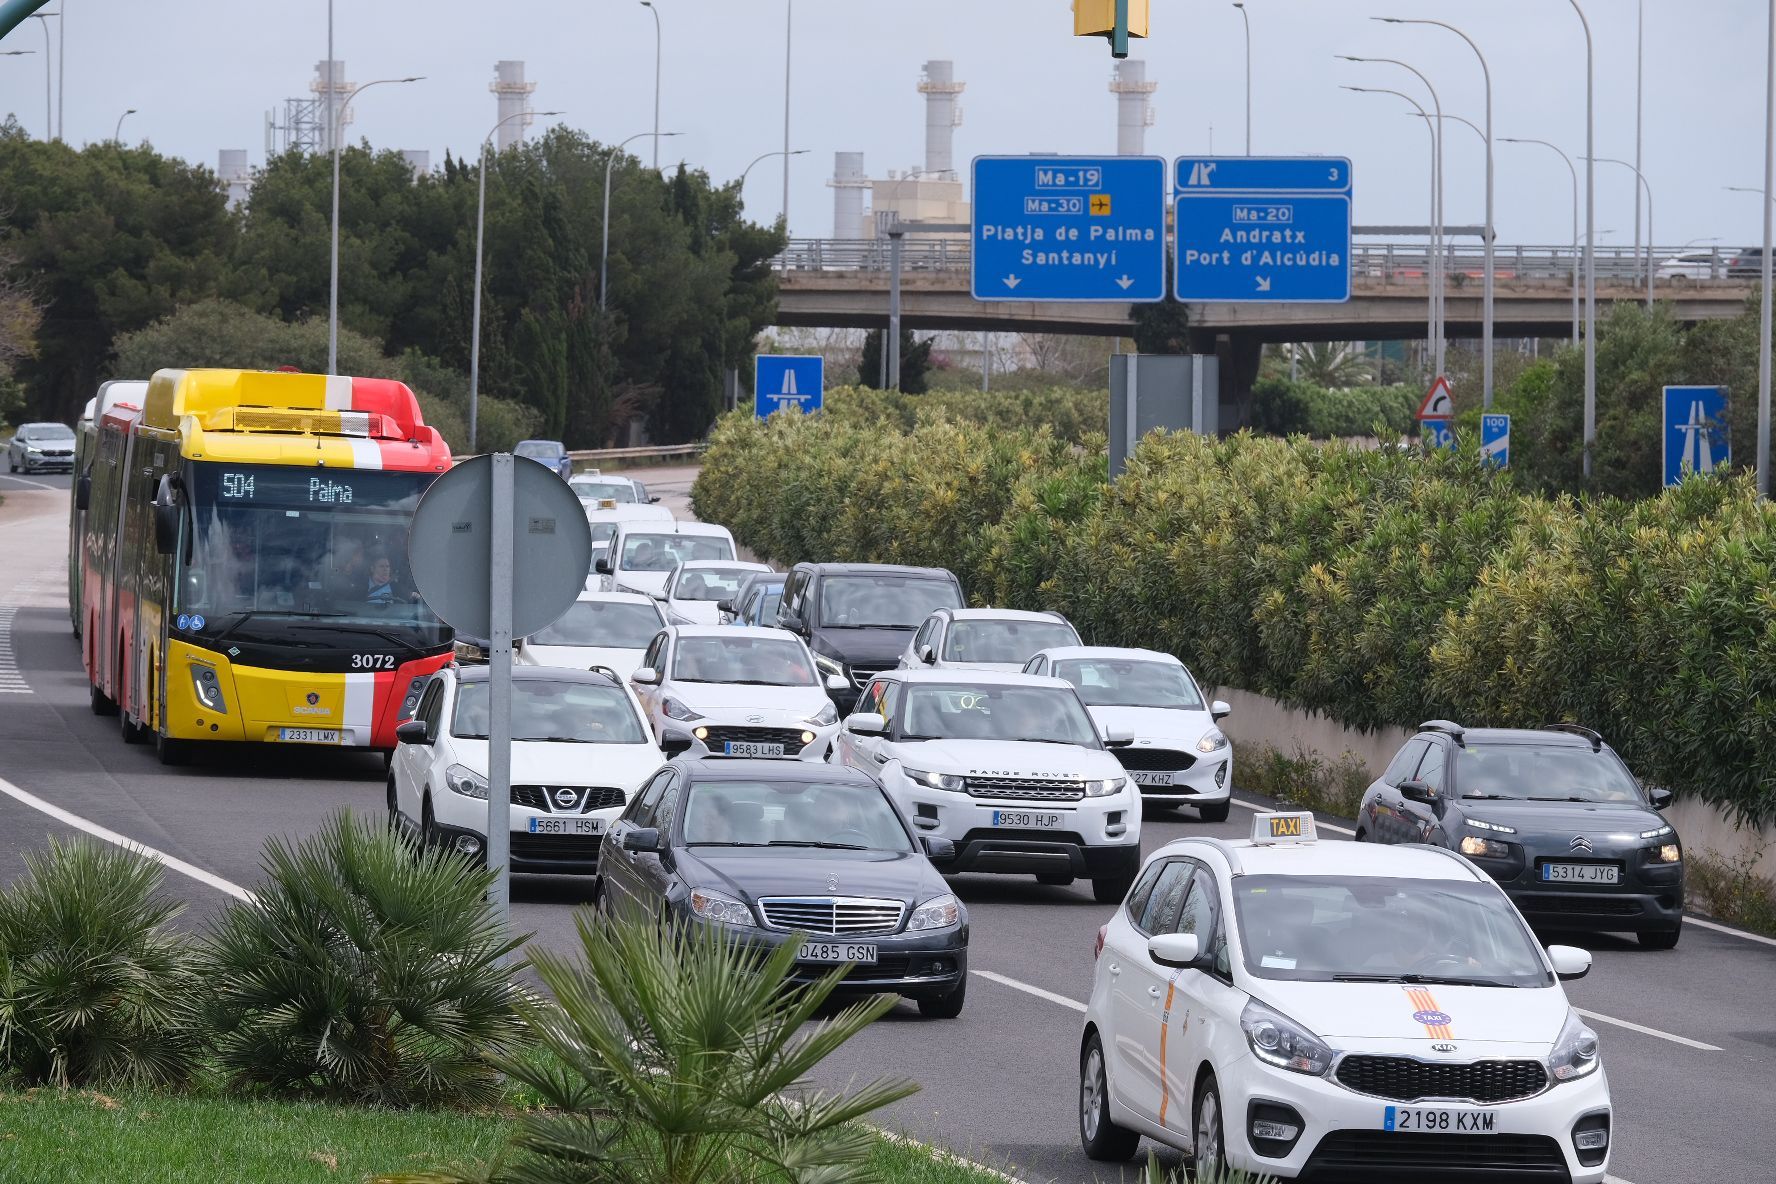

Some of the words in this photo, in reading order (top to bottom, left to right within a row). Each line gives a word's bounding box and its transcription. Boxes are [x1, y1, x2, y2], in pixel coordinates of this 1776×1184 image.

[1037, 170, 1100, 186] Ma-19
[1328, 168, 1339, 181] 3
[1026, 199, 1080, 212] Ma-30
[1235, 207, 1290, 221] Ma-20
[982, 225, 1044, 244] Platja
[1055, 226, 1079, 241] de
[1090, 226, 1155, 241] Palma
[1219, 228, 1306, 244] Andratx
[1021, 249, 1117, 269] Santanyí
[1186, 250, 1231, 265] Port
[1241, 251, 1340, 266] d'Alcúdia
[1486, 418, 1505, 427] 100
[223, 473, 255, 498] 504
[309, 477, 353, 503] Palma
[351, 654, 395, 669] 3072
[289, 730, 313, 741] 2331
[317, 731, 336, 742] LMX
[732, 744, 758, 755] 9583
[761, 745, 781, 756] LHS
[1151, 774, 1172, 785] KHZ
[538, 820, 567, 833] 5661
[575, 821, 599, 834] HSM
[1000, 813, 1030, 826] 9530
[1035, 814, 1059, 827] HJP
[1270, 818, 1300, 836] TAXI
[1552, 866, 1585, 880] 5314
[1590, 867, 1614, 881] JYG
[800, 944, 840, 960] 0485
[847, 945, 875, 961] GSN
[1400, 1110, 1450, 1130] 2198
[1456, 1112, 1494, 1131] KXM
